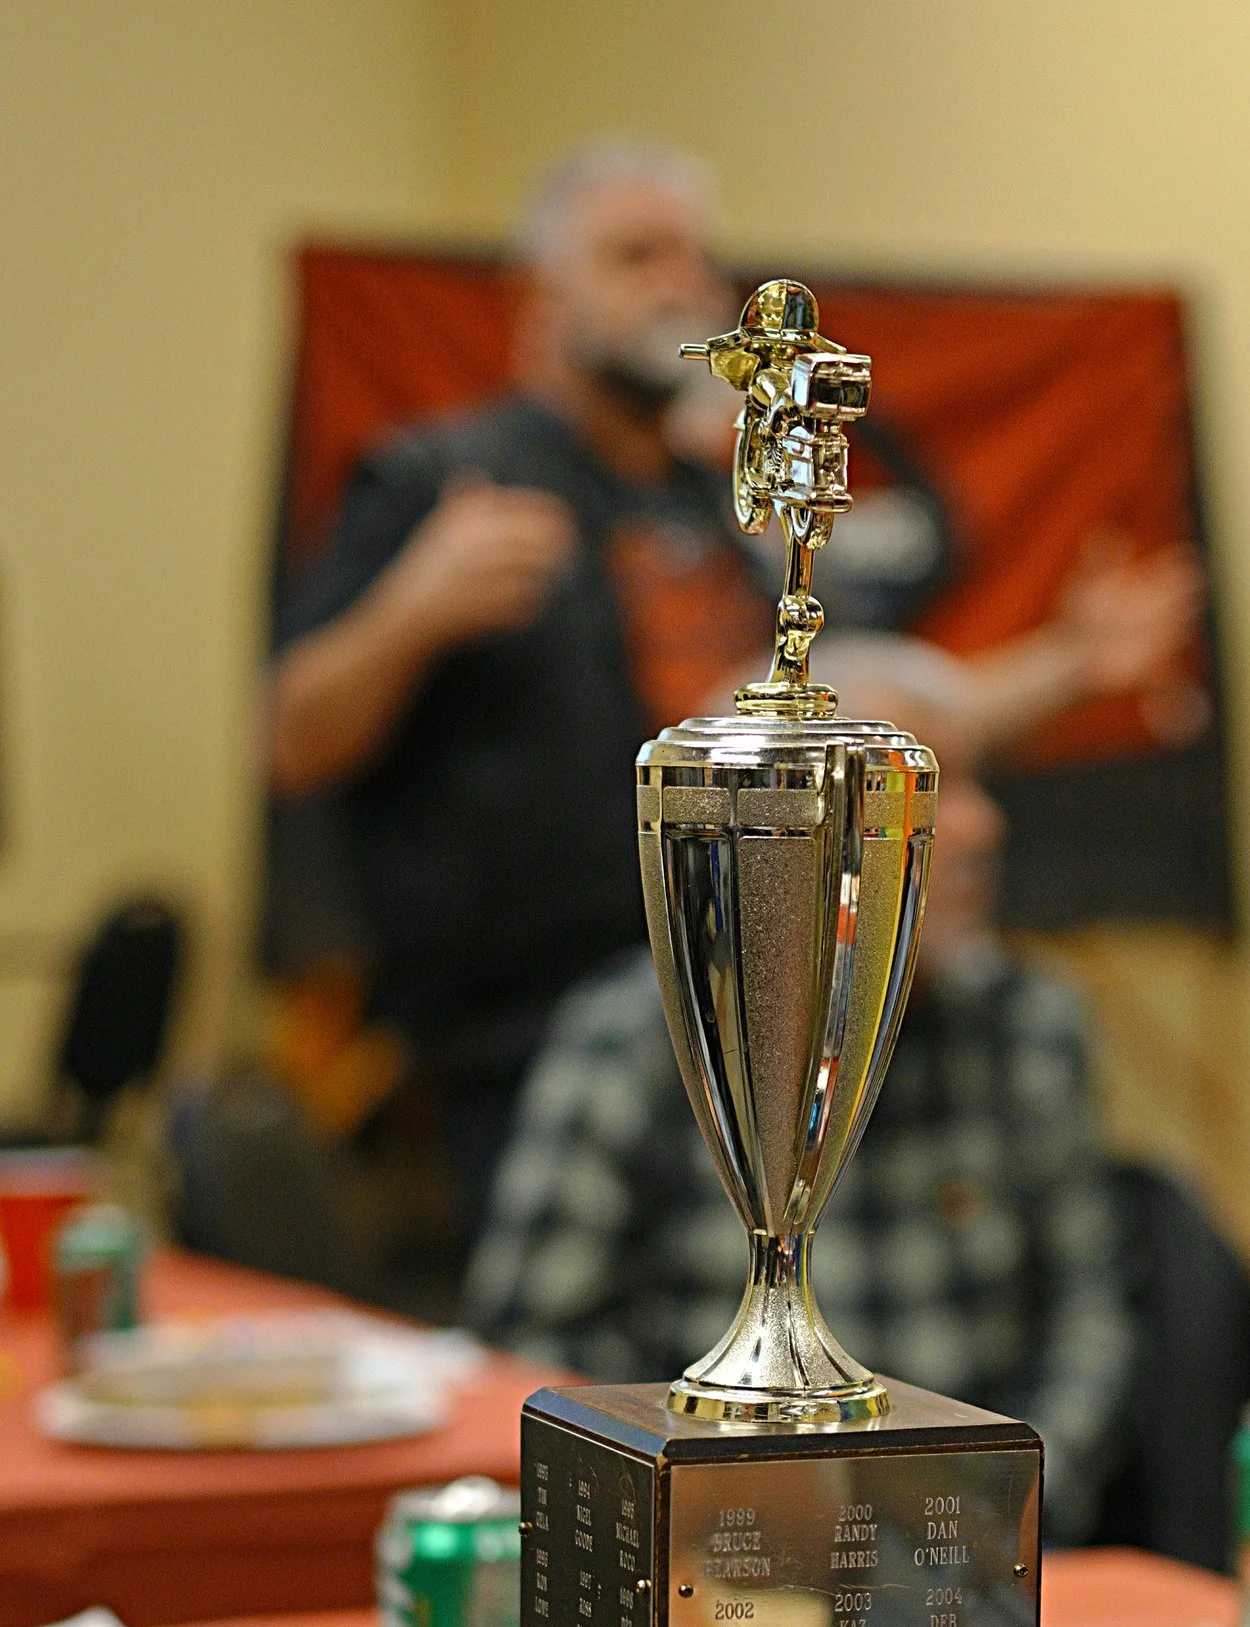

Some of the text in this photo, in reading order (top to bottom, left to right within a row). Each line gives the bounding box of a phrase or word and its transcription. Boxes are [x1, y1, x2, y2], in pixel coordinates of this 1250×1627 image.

[838, 1503, 873, 1522] 2000
[924, 1496, 961, 1516] 2001
[719, 1508, 756, 1527] 1999
[833, 1524, 878, 1543] RANDY
[926, 1520, 959, 1540] DAN
[712, 1531, 762, 1552] BRUCE
[830, 1550, 879, 1569] HARRIS
[914, 1545, 970, 1567] O'NEILL
[703, 1557, 772, 1579] PEARSON
[834, 1592, 873, 1613] 2003
[925, 1587, 963, 1606] 2004
[714, 1601, 755, 1620] 2002
